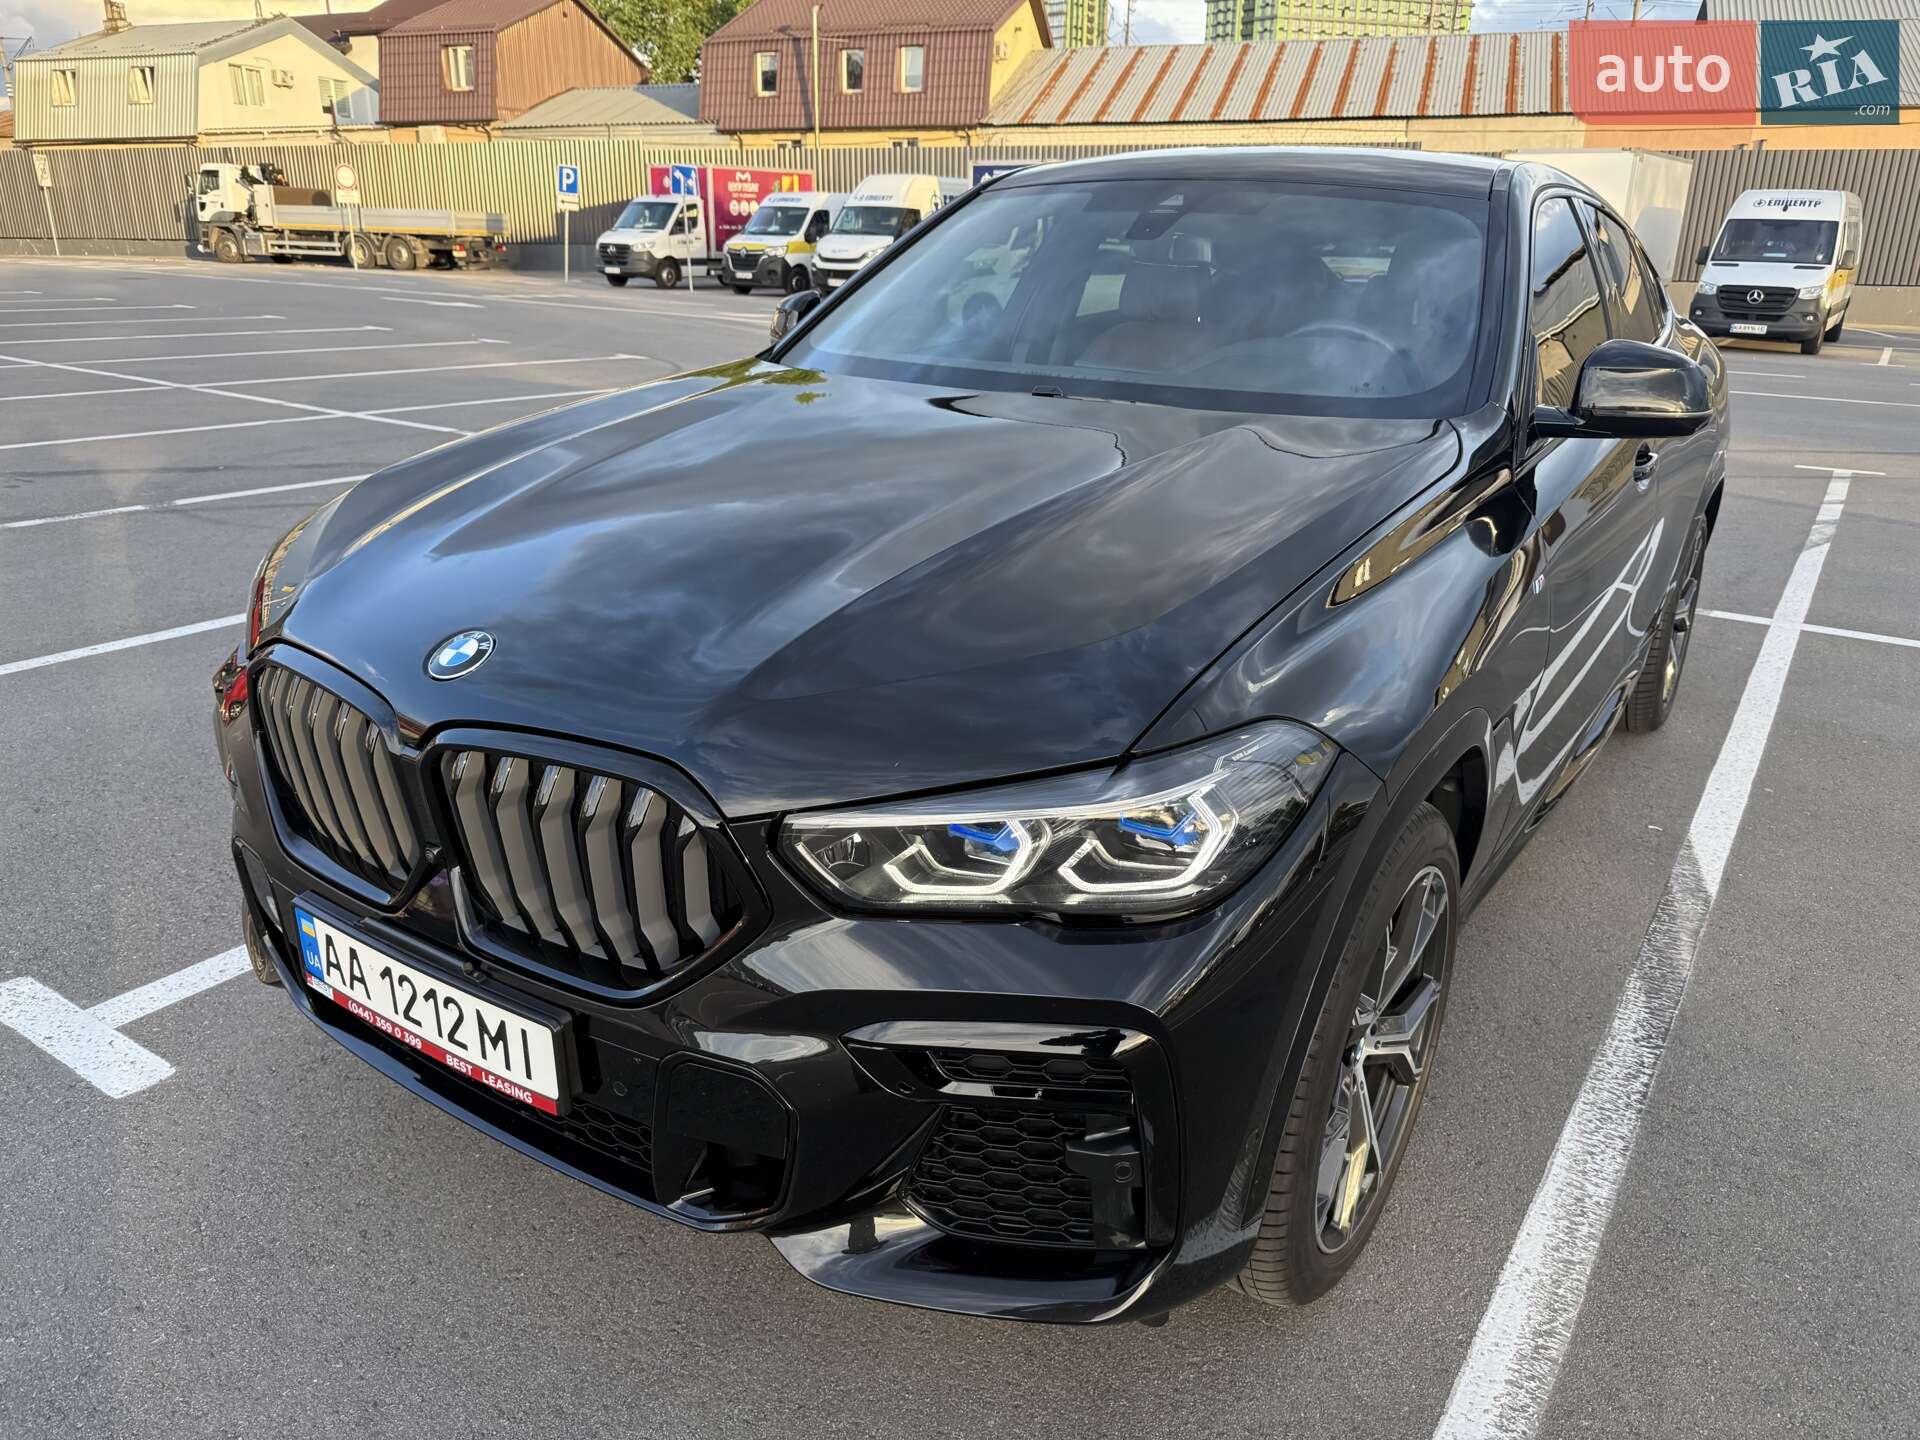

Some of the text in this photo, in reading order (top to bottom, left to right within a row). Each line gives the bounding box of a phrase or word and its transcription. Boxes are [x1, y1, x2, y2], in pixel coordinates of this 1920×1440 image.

[562, 168, 575, 192] P
[306, 950, 322, 970] UA
[325, 933, 532, 1081] AA 1212 MI
[348, 1000, 533, 1104] (044) 359 0 399 BEST LEASING
